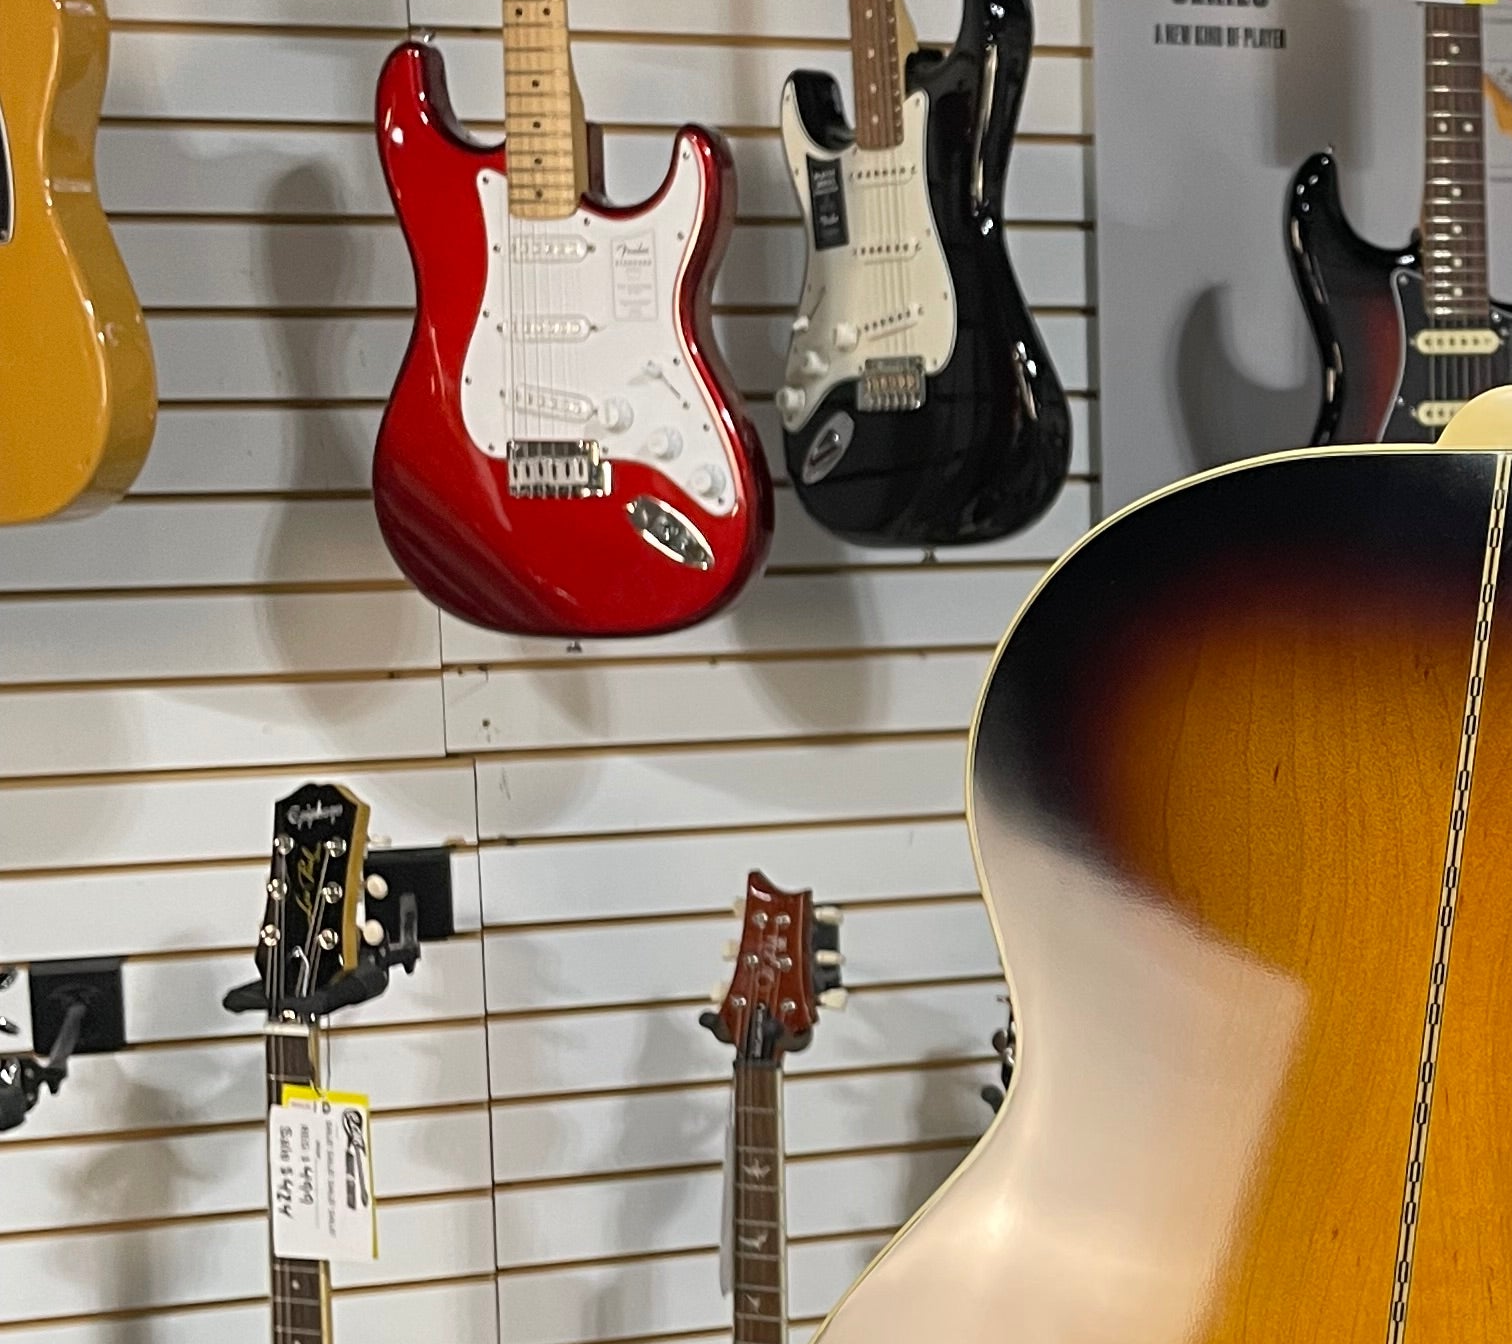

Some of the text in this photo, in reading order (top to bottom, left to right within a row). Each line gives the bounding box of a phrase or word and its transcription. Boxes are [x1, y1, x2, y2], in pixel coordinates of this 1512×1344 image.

[1154, 23, 1164, 46] A
[287, 799, 344, 831] Epiphone
[280, 1125, 293, 1162] Sale
